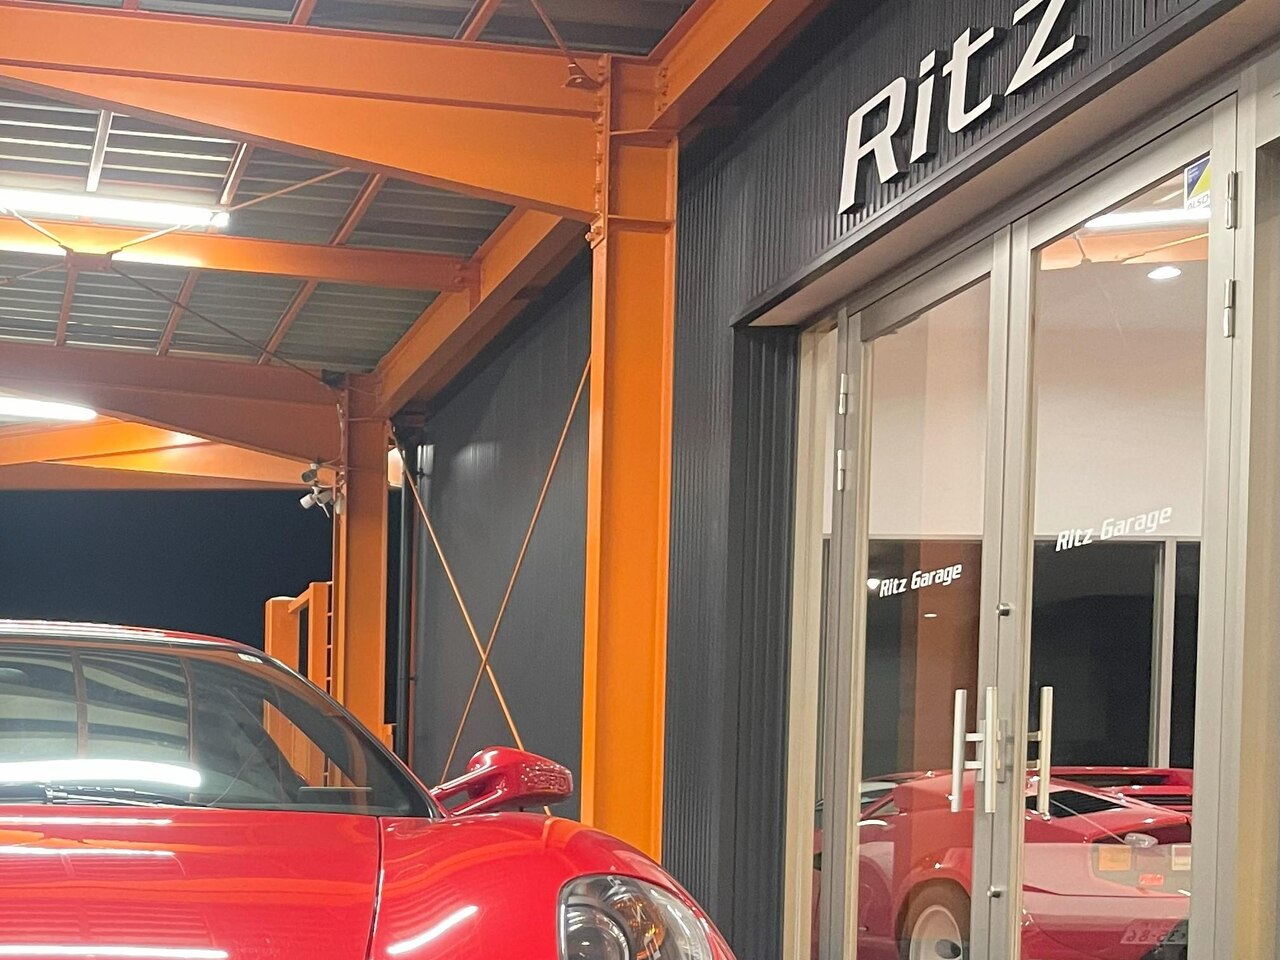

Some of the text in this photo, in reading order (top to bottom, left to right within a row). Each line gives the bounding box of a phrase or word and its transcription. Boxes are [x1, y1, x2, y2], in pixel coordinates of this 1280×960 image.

[838, 0, 1076, 215] Ritz
[1054, 506, 1173, 552] Ritz Garage
[879, 563, 963, 598] Ritz Garage
